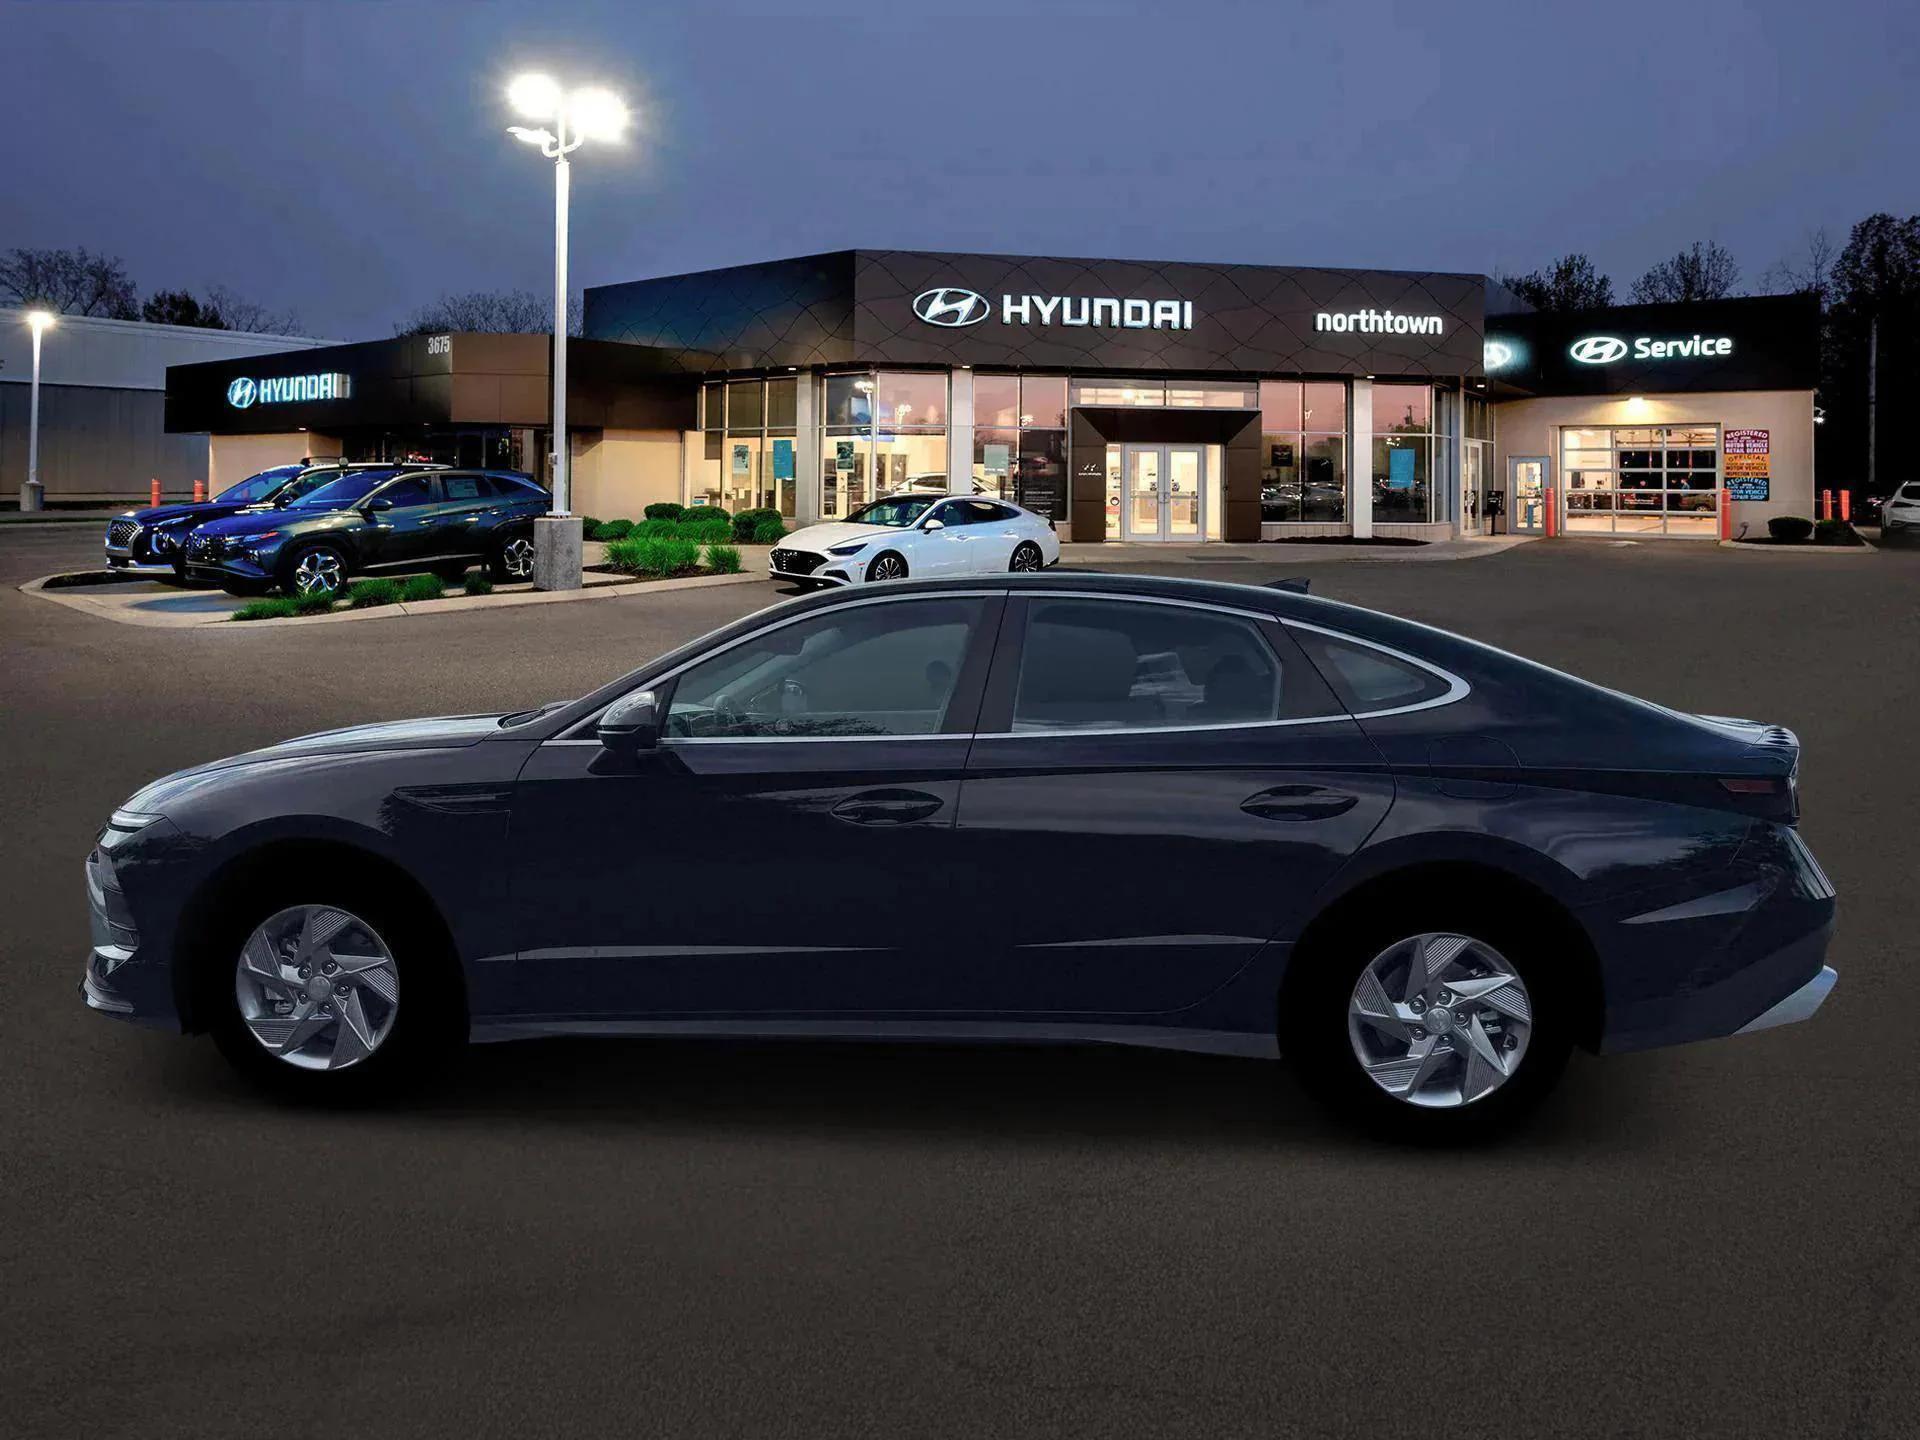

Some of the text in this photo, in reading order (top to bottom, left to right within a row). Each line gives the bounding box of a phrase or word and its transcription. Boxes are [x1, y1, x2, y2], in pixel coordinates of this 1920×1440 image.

[1002, 294, 1193, 330] HYUNDAI
[1316, 308, 1443, 335] northtown
[427, 335, 451, 355] 3675
[1633, 334, 1733, 359] Service
[259, 372, 347, 404] HYUNDAI
[1725, 430, 1768, 439] REGISTERED
[1727, 454, 1767, 462] OFFICIAL
[1726, 477, 1768, 486] REGISTERED
